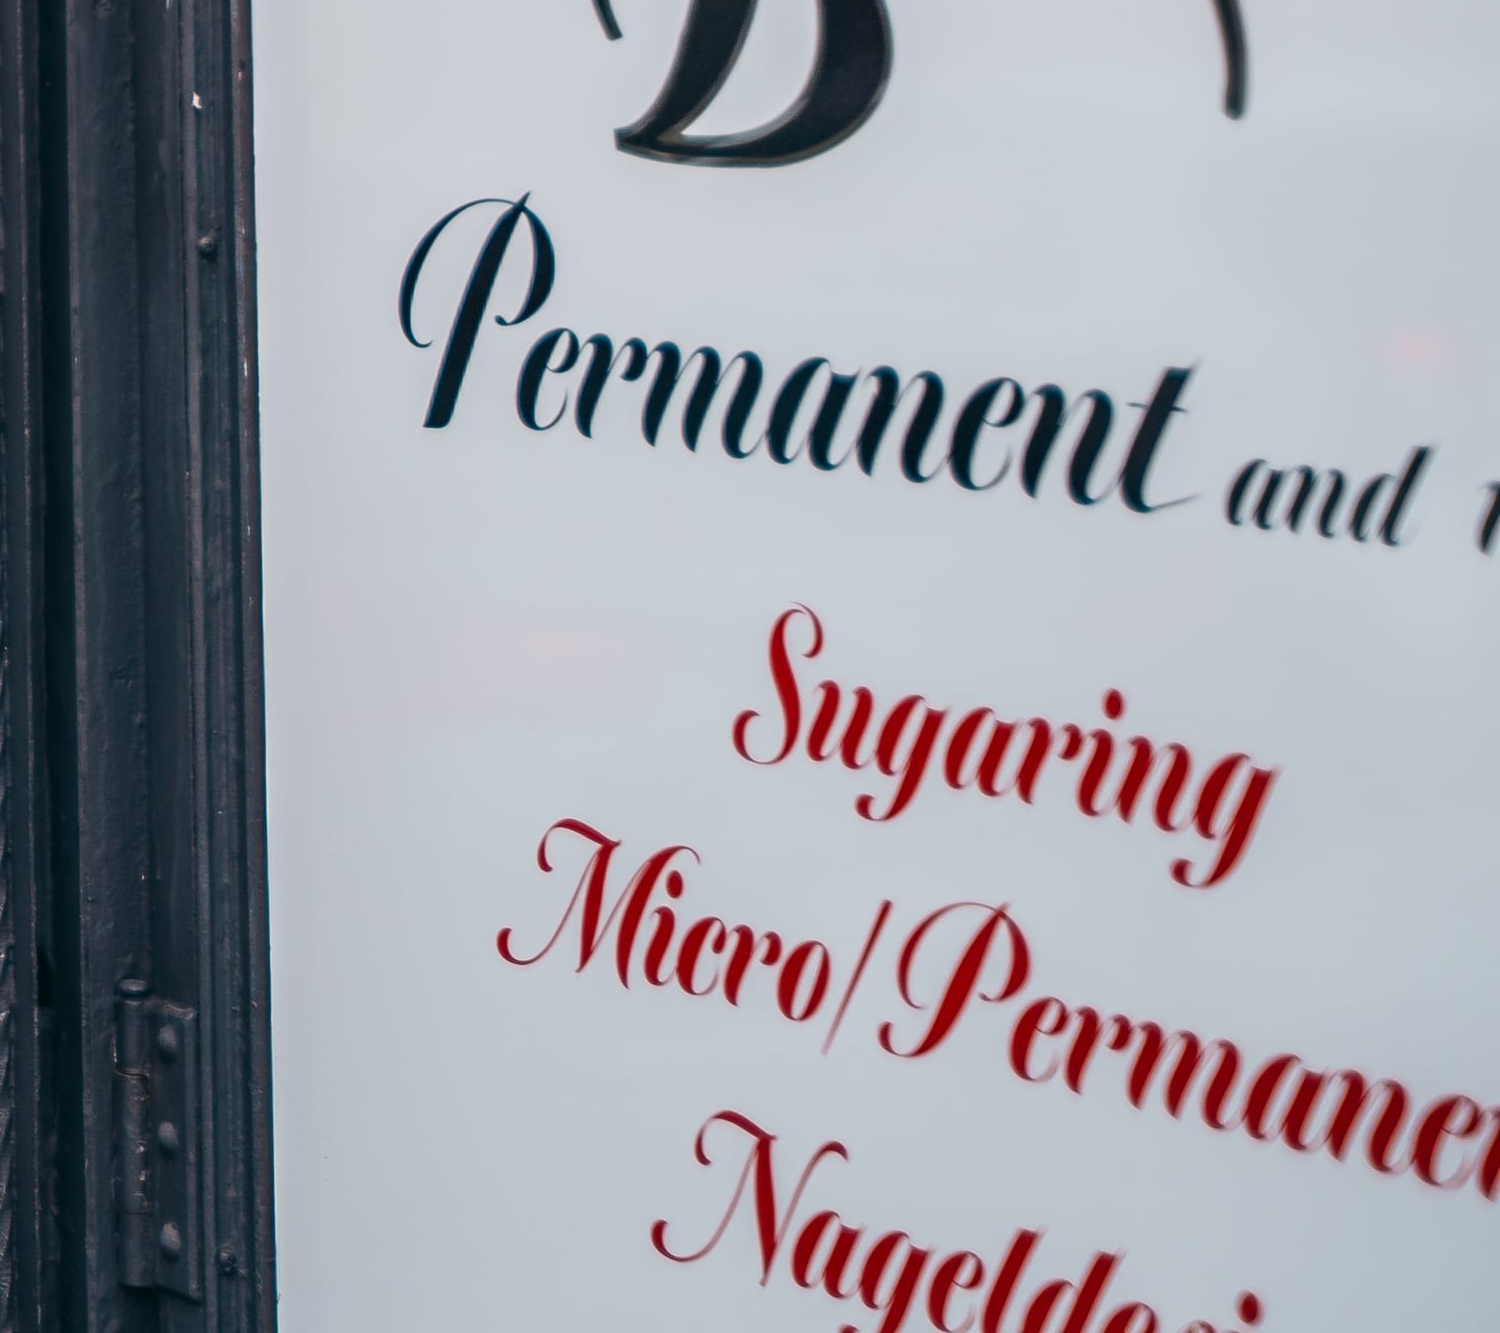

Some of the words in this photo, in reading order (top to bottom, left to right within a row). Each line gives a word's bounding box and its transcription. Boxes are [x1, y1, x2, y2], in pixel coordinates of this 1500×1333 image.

[398, 191, 1202, 515] Permanent
[1224, 441, 1442, 549] and
[732, 601, 1282, 889] Sugaring
